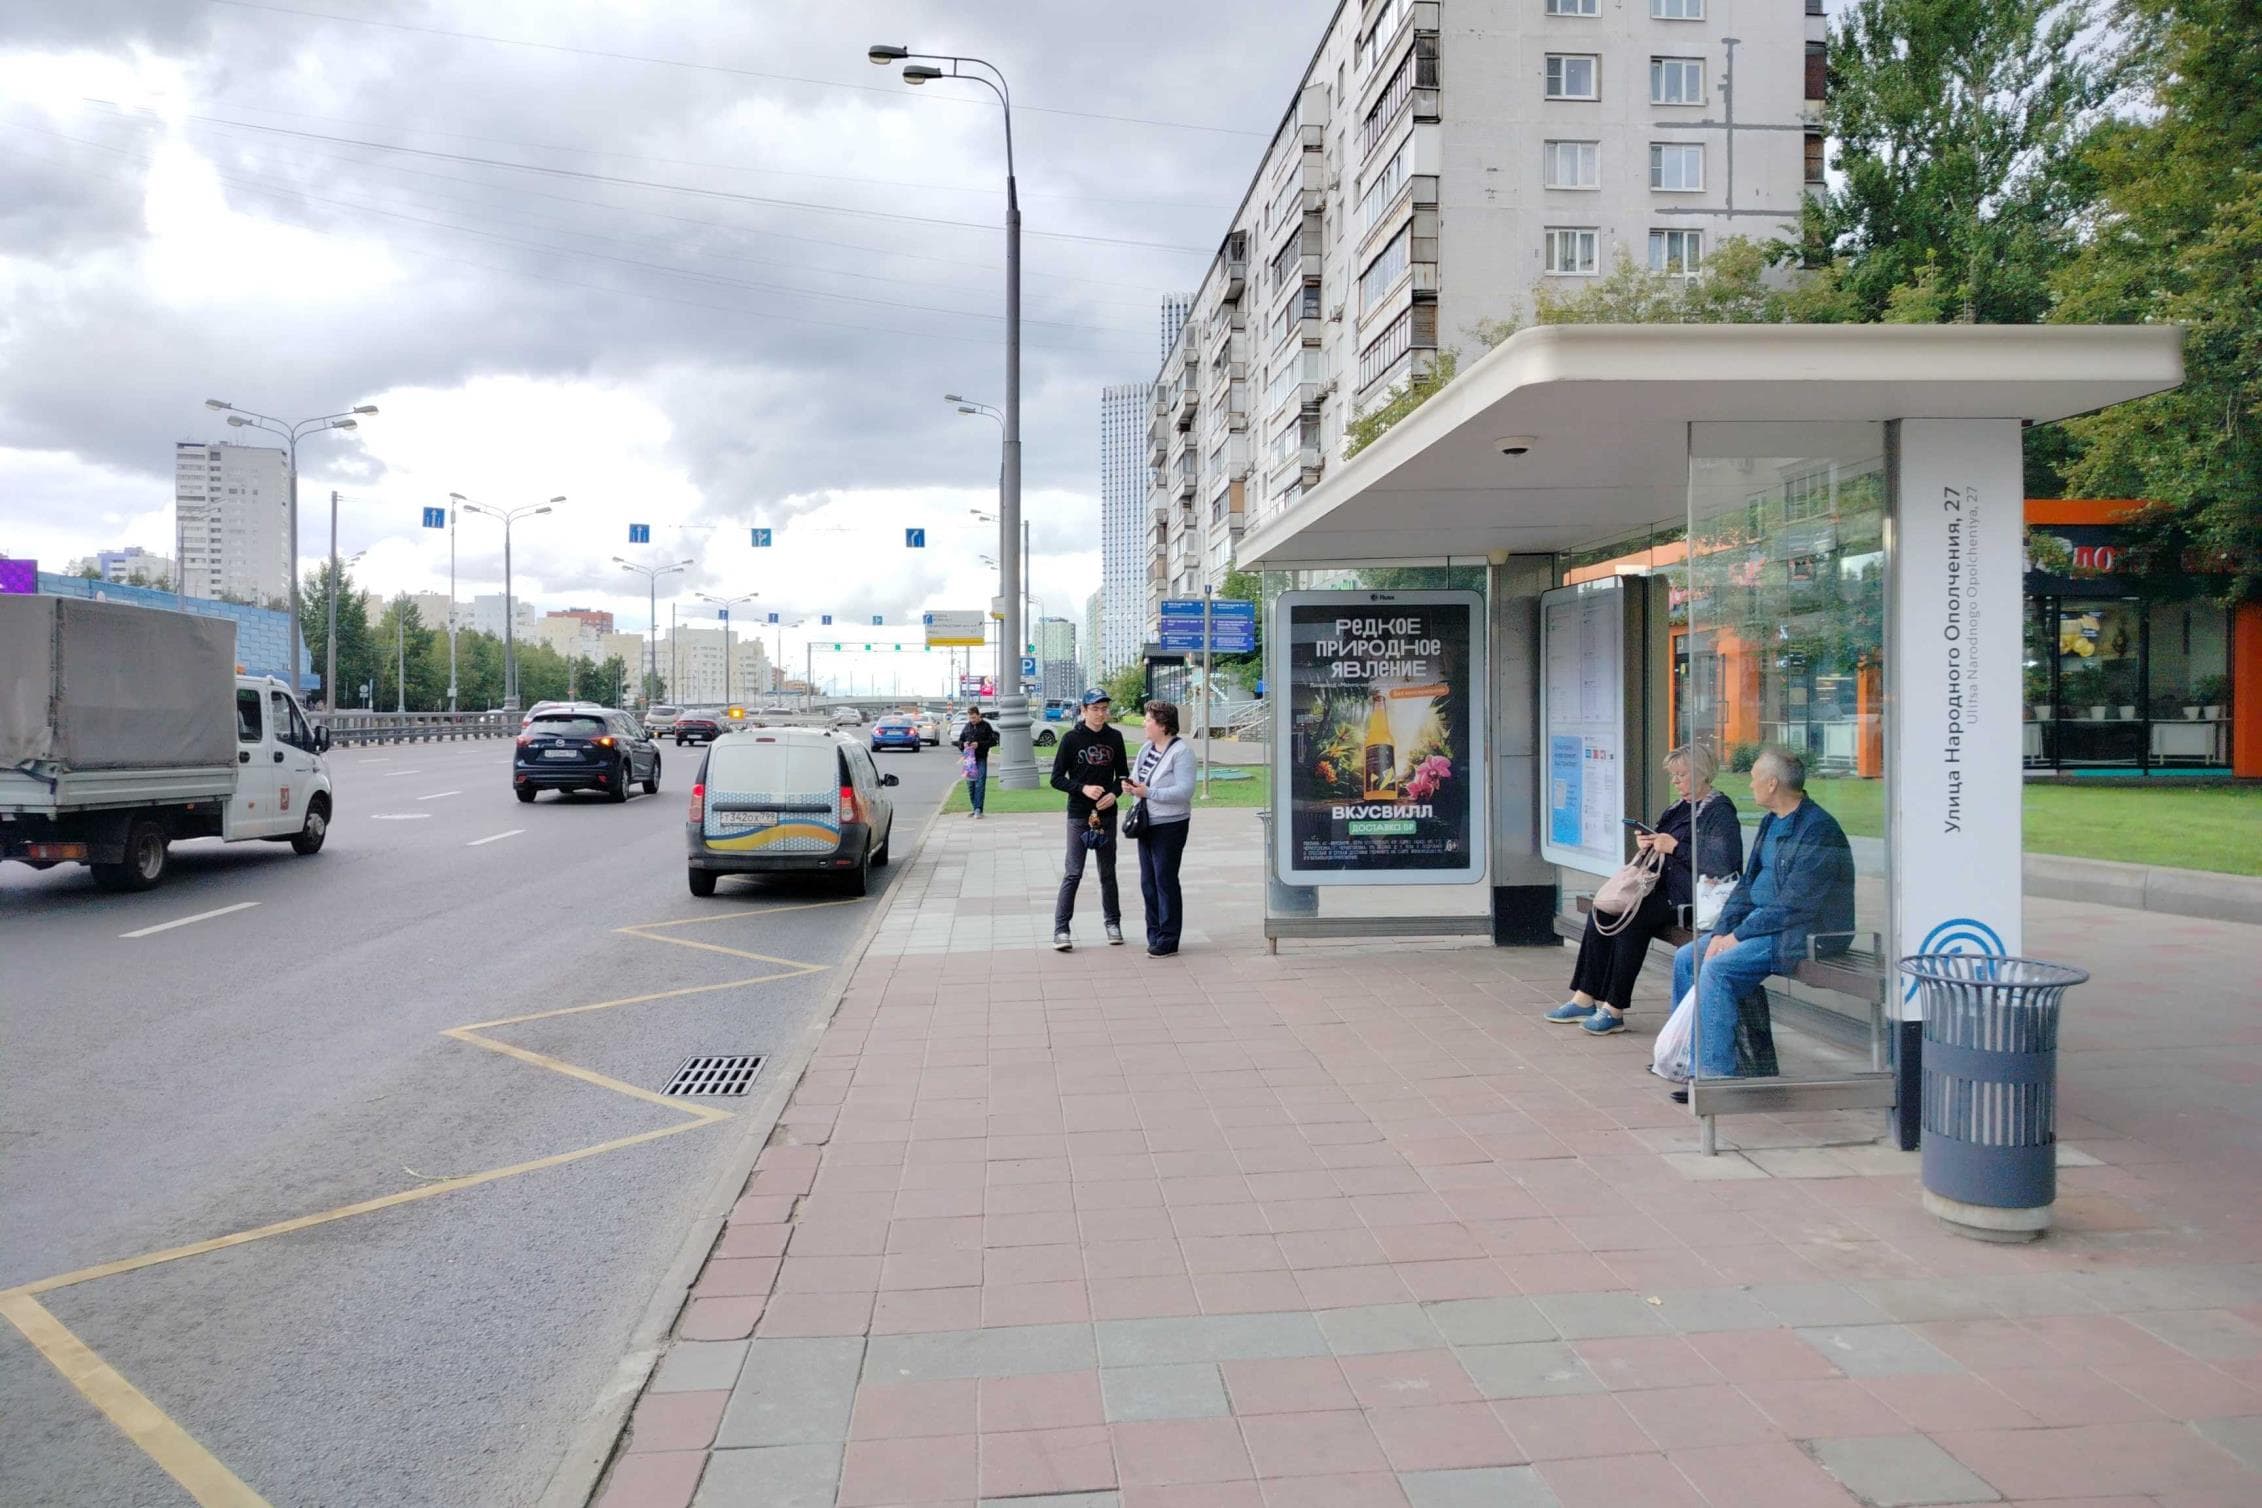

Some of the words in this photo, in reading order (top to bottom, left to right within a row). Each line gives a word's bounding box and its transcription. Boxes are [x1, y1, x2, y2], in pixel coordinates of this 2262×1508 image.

[1944, 486, 1960, 512] 27
[1966, 485, 1978, 503] 27
[1944, 518, 1963, 641] Ополчения,
[1966, 506, 1981, 598] Opolcheniya,
[1966, 601, 1981, 680] Narodnogo
[1944, 647, 1964, 763] Народного
[1966, 684, 1978, 724] Ulitsa
[1332, 805, 1433, 820] ВКУСВИЛЛ
[1944, 770, 1962, 833] Улица
